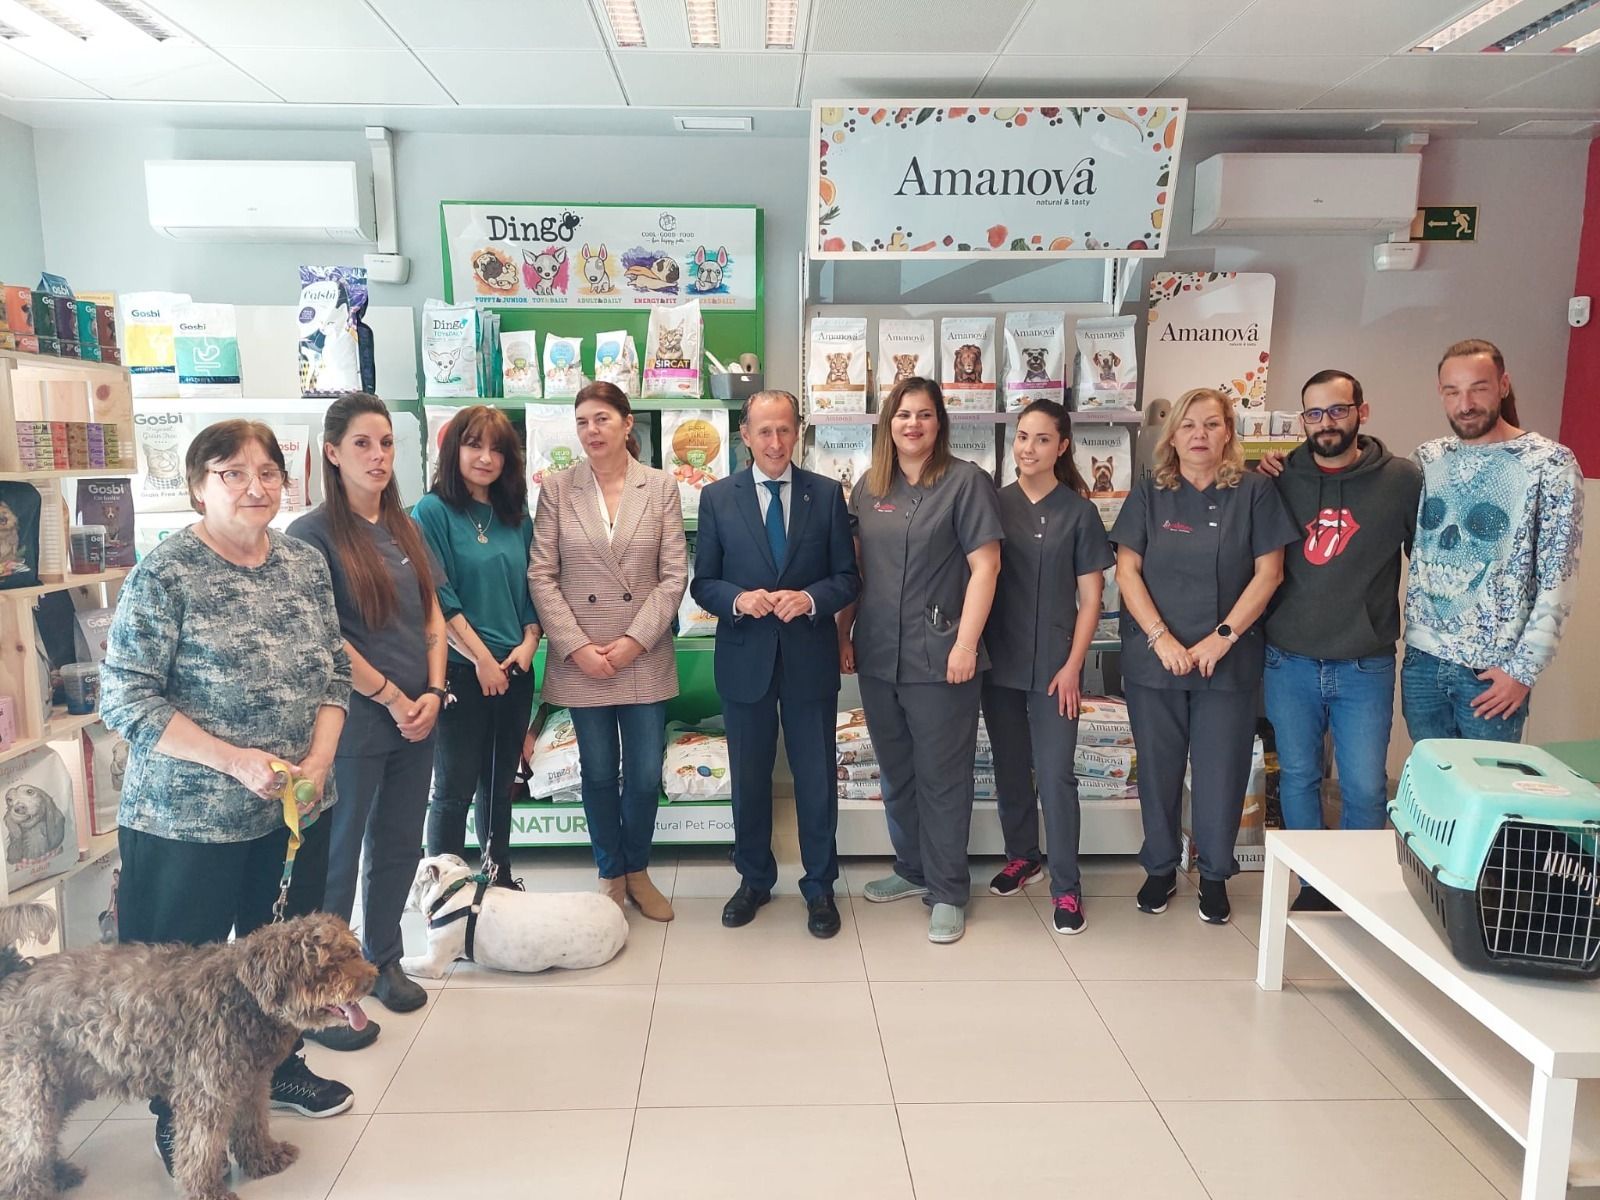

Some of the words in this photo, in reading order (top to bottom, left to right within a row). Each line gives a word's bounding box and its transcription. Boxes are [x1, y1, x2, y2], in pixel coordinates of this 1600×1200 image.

[1035, 198, 1062, 206] natural
[1071, 199, 1090, 207] tasty
[486, 215, 574, 242] Dingo
[131, 309, 160, 318] Gosbi
[180, 323, 207, 331] Gosbi
[433, 319, 465, 330] Dingo
[655, 359, 690, 369] SIRCAT
[134, 411, 183, 426] Gosbi
[88, 484, 124, 494] Gosbi
[656, 821, 682, 830] tural
[685, 820, 705, 830] Pet
